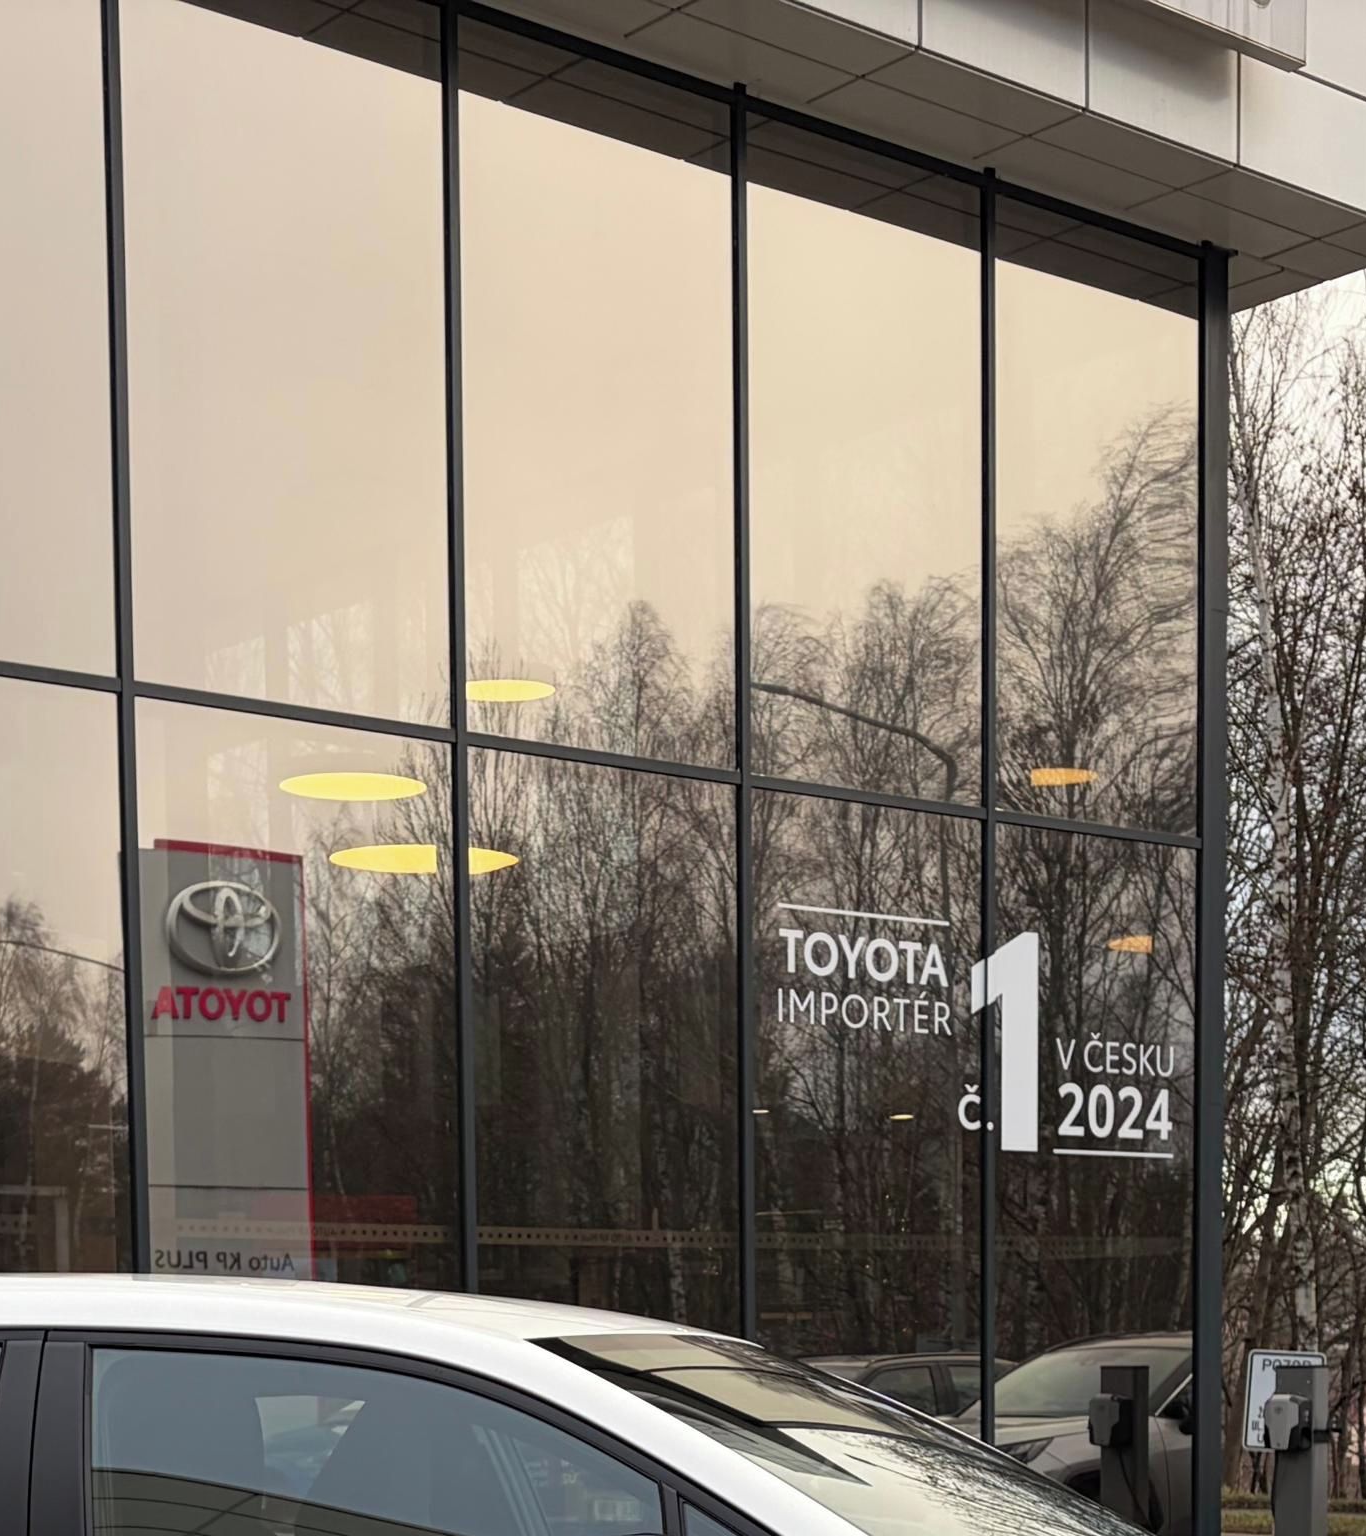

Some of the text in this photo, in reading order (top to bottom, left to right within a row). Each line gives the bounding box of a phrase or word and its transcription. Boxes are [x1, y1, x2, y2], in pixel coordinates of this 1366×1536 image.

[778, 927, 949, 988] TOYOTA
[777, 986, 953, 1036] IMPORTÉR
[971, 932, 1039, 1152] 1
[1056, 1033, 1175, 1078] V ČESKU
[1057, 1082, 1172, 1141] 2024
